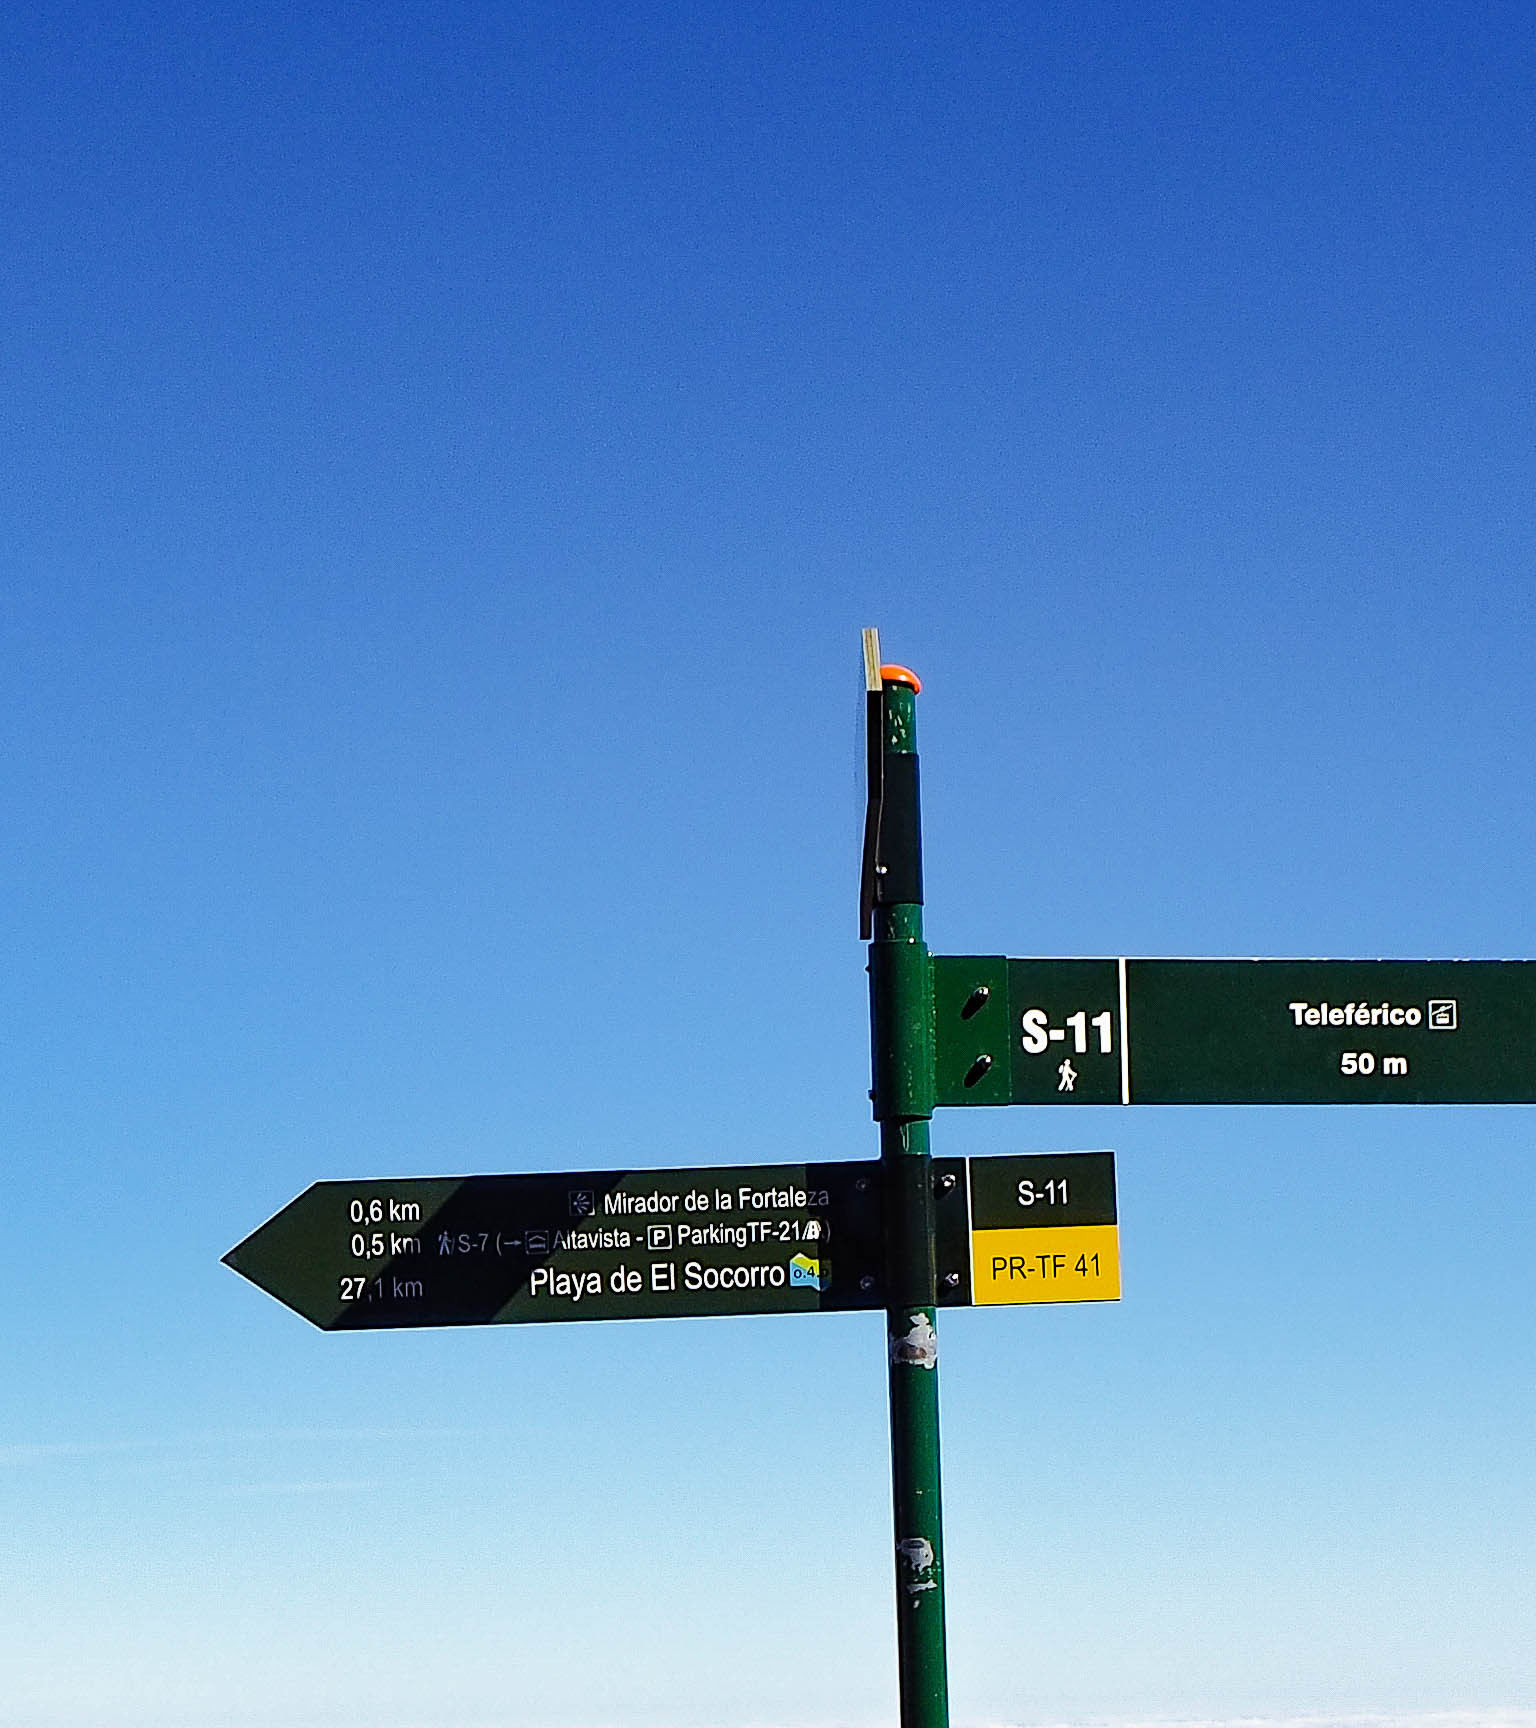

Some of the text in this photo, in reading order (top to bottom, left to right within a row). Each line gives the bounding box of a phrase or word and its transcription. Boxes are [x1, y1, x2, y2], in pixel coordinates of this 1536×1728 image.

[1289, 1002, 1421, 1027] Teleférico
[1022, 1009, 1112, 1053] S-11
[1340, 1053, 1408, 1075] 50 m
[604, 1186, 830, 1215] Mirador de la Fortaleza
[1018, 1179, 1068, 1206] S-11
[350, 1199, 420, 1226] 0,6 km
[351, 1233, 421, 1259] 0,5 km
[458, 1233, 489, 1254] S-7
[553, 1228, 631, 1249] Altavista
[677, 1220, 800, 1248] ParkingTF-21
[992, 1252, 1100, 1280] PR-TF 41
[340, 1276, 423, 1302] 27,1 km
[530, 1261, 785, 1301] Playa de El Socorro
